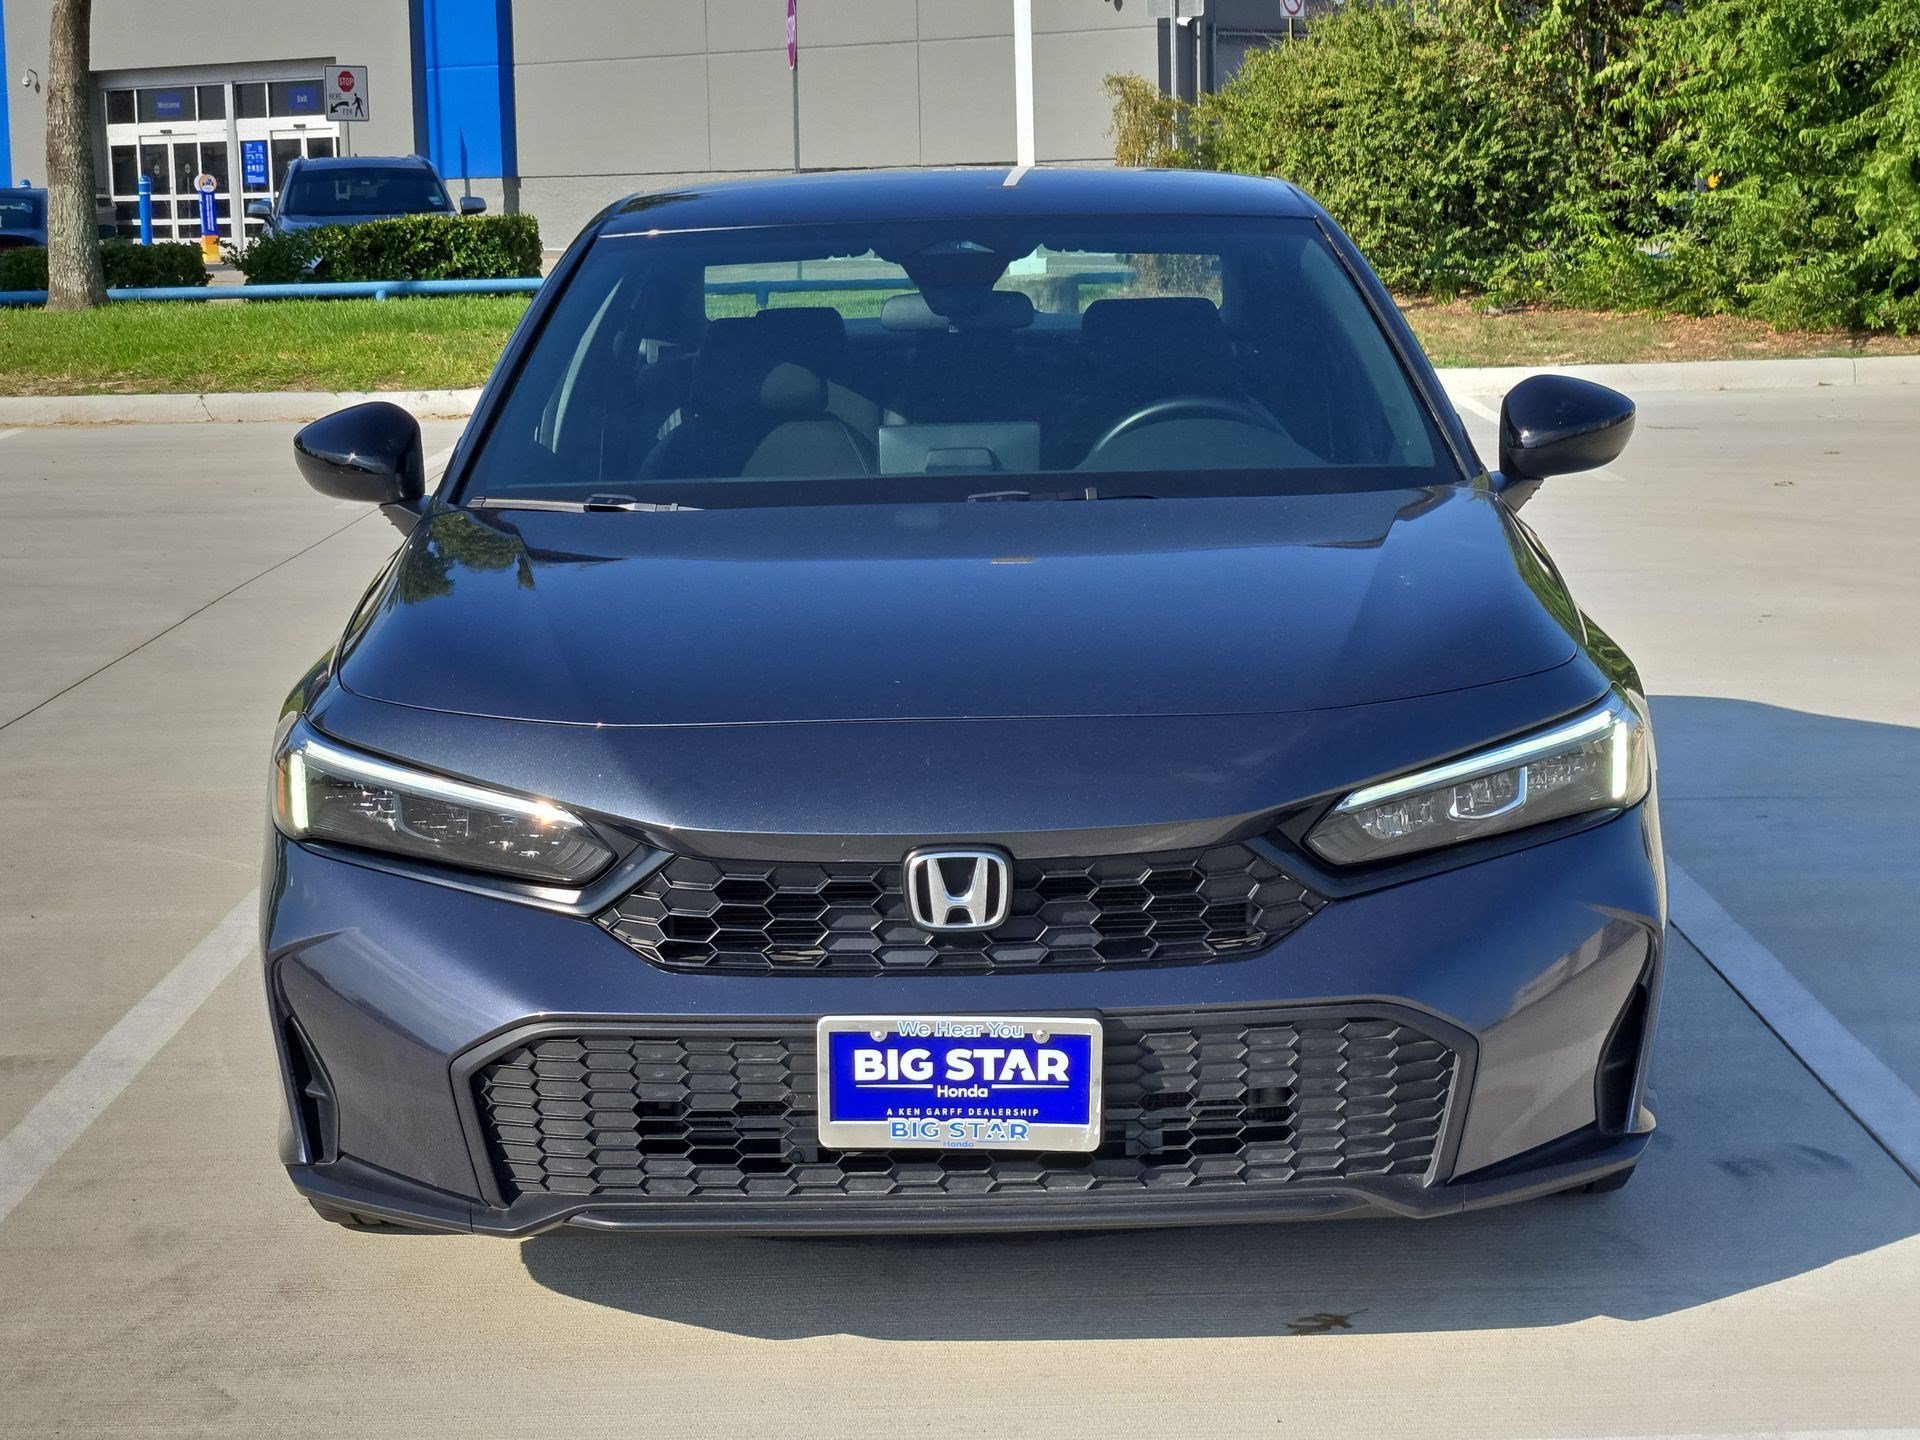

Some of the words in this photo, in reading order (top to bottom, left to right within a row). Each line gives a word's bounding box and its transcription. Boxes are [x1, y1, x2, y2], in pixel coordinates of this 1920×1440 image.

[339, 77, 354, 87] STOP
[328, 92, 342, 101] HERE
[342, 107, 353, 116] FOR
[898, 1020, 931, 1037] We
[933, 1022, 984, 1038] Hear
[986, 1022, 1026, 1039] You
[853, 1048, 934, 1082] BIG
[945, 1048, 1070, 1082] STAR
[936, 1084, 989, 1099] Honda
[886, 1108, 893, 1117] A
[898, 1108, 921, 1117] KEN
[925, 1108, 963, 1117] GARFF
[968, 1108, 1040, 1117] DEALERSHIP
[890, 1120, 940, 1139] BIG
[948, 1120, 1030, 1140] STAR
[942, 1140, 975, 1149] Honda
